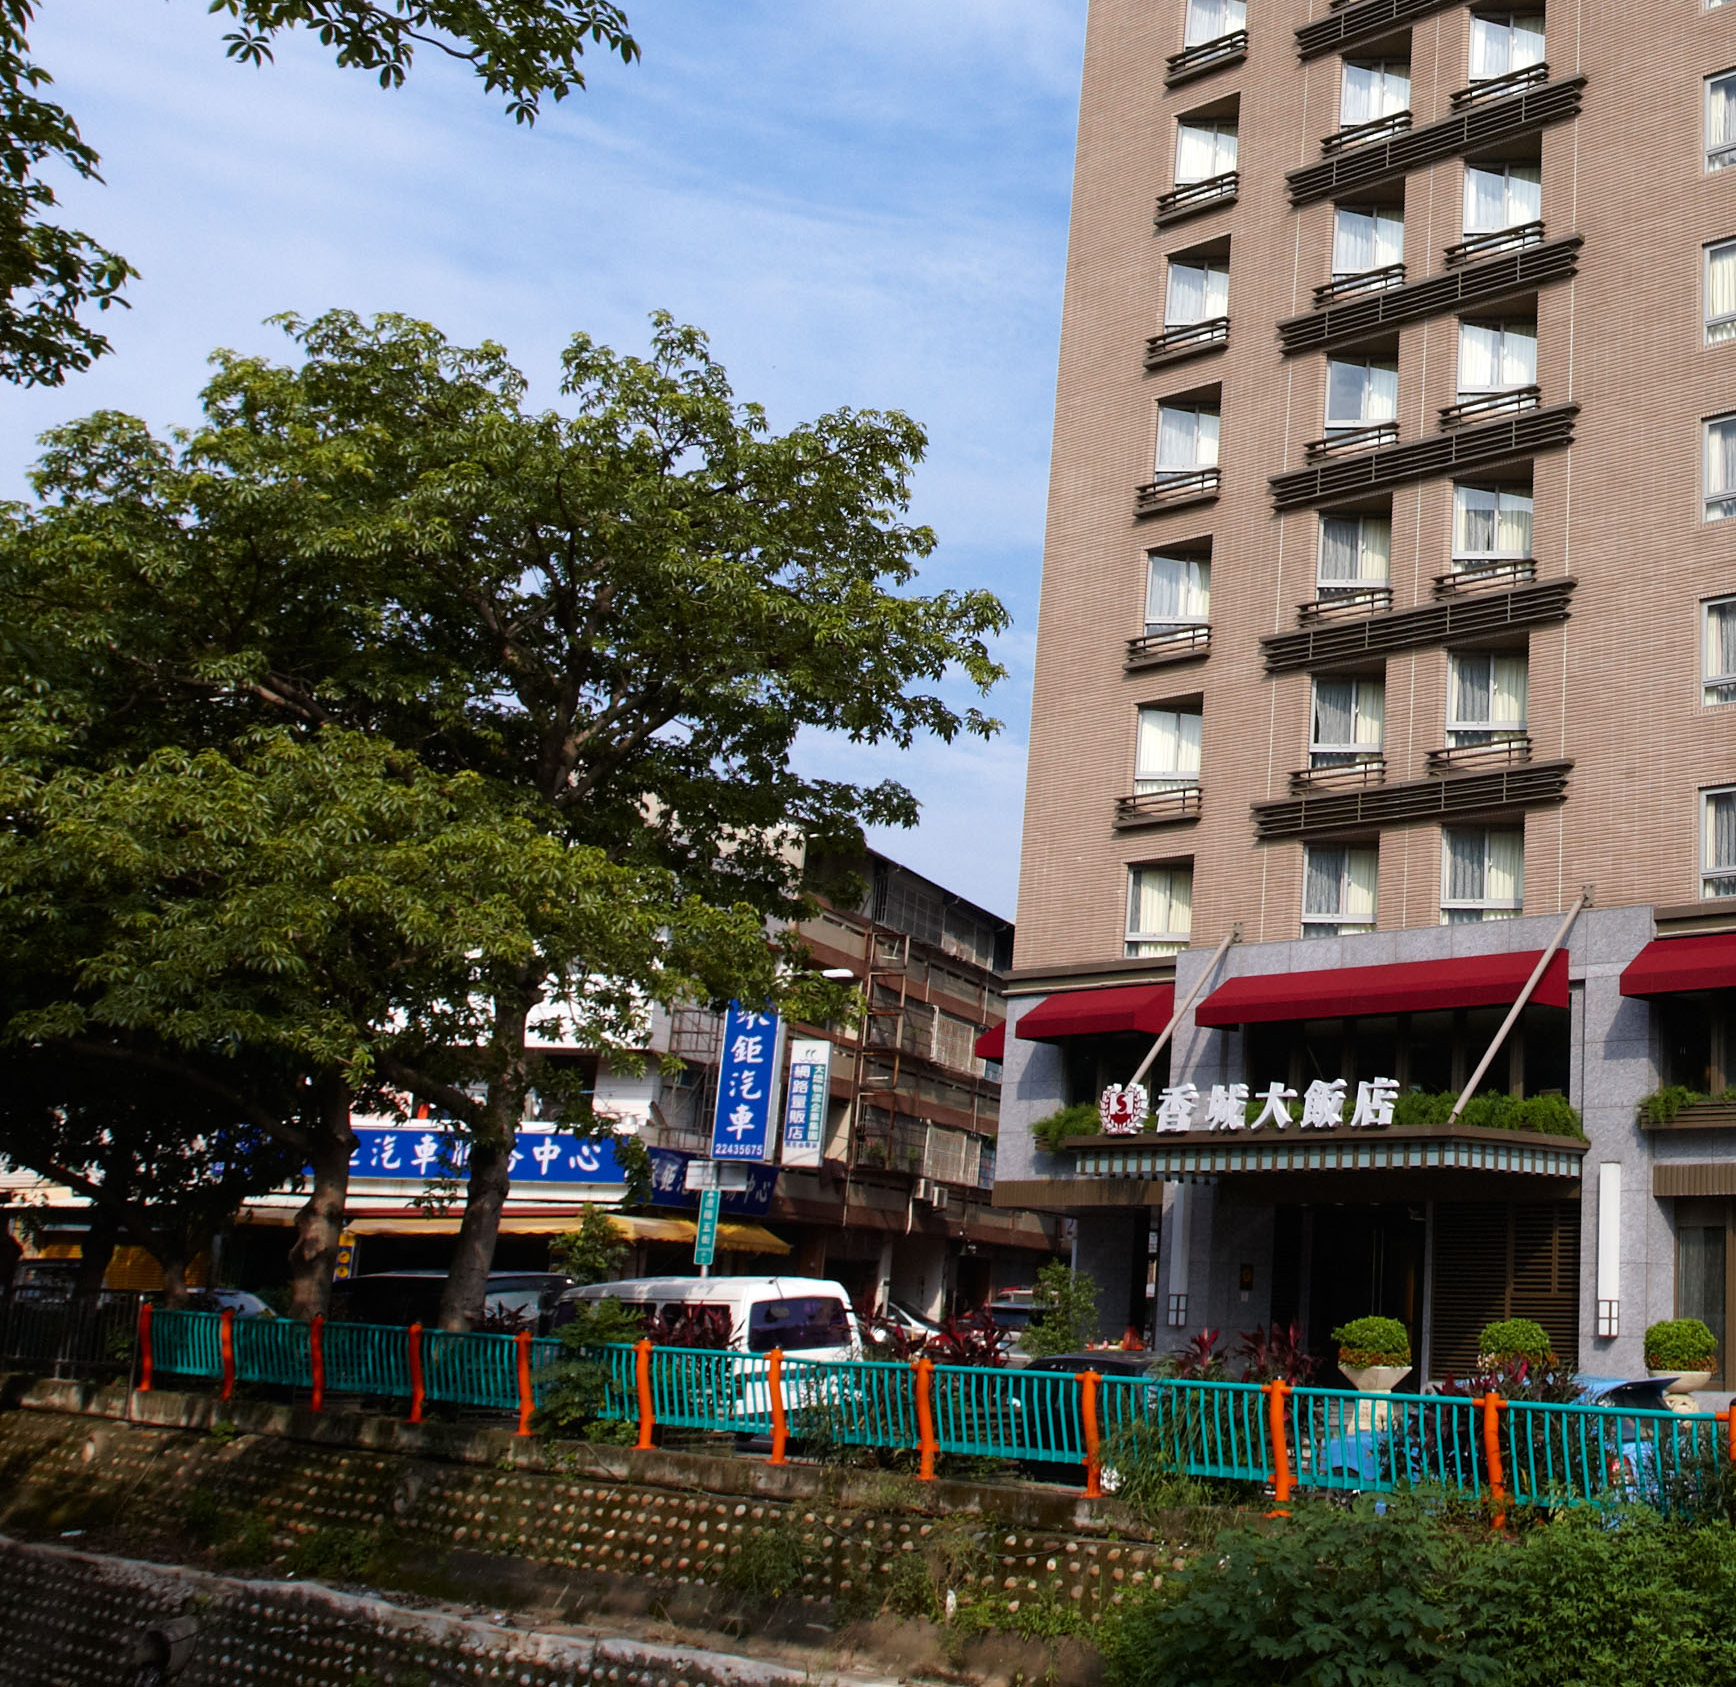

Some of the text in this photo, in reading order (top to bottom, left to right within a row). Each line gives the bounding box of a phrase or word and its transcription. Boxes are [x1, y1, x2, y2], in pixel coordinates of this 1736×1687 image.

[1156, 1076, 1400, 1134] 香城大飯店
[715, 1143, 763, 1156] 22435675
